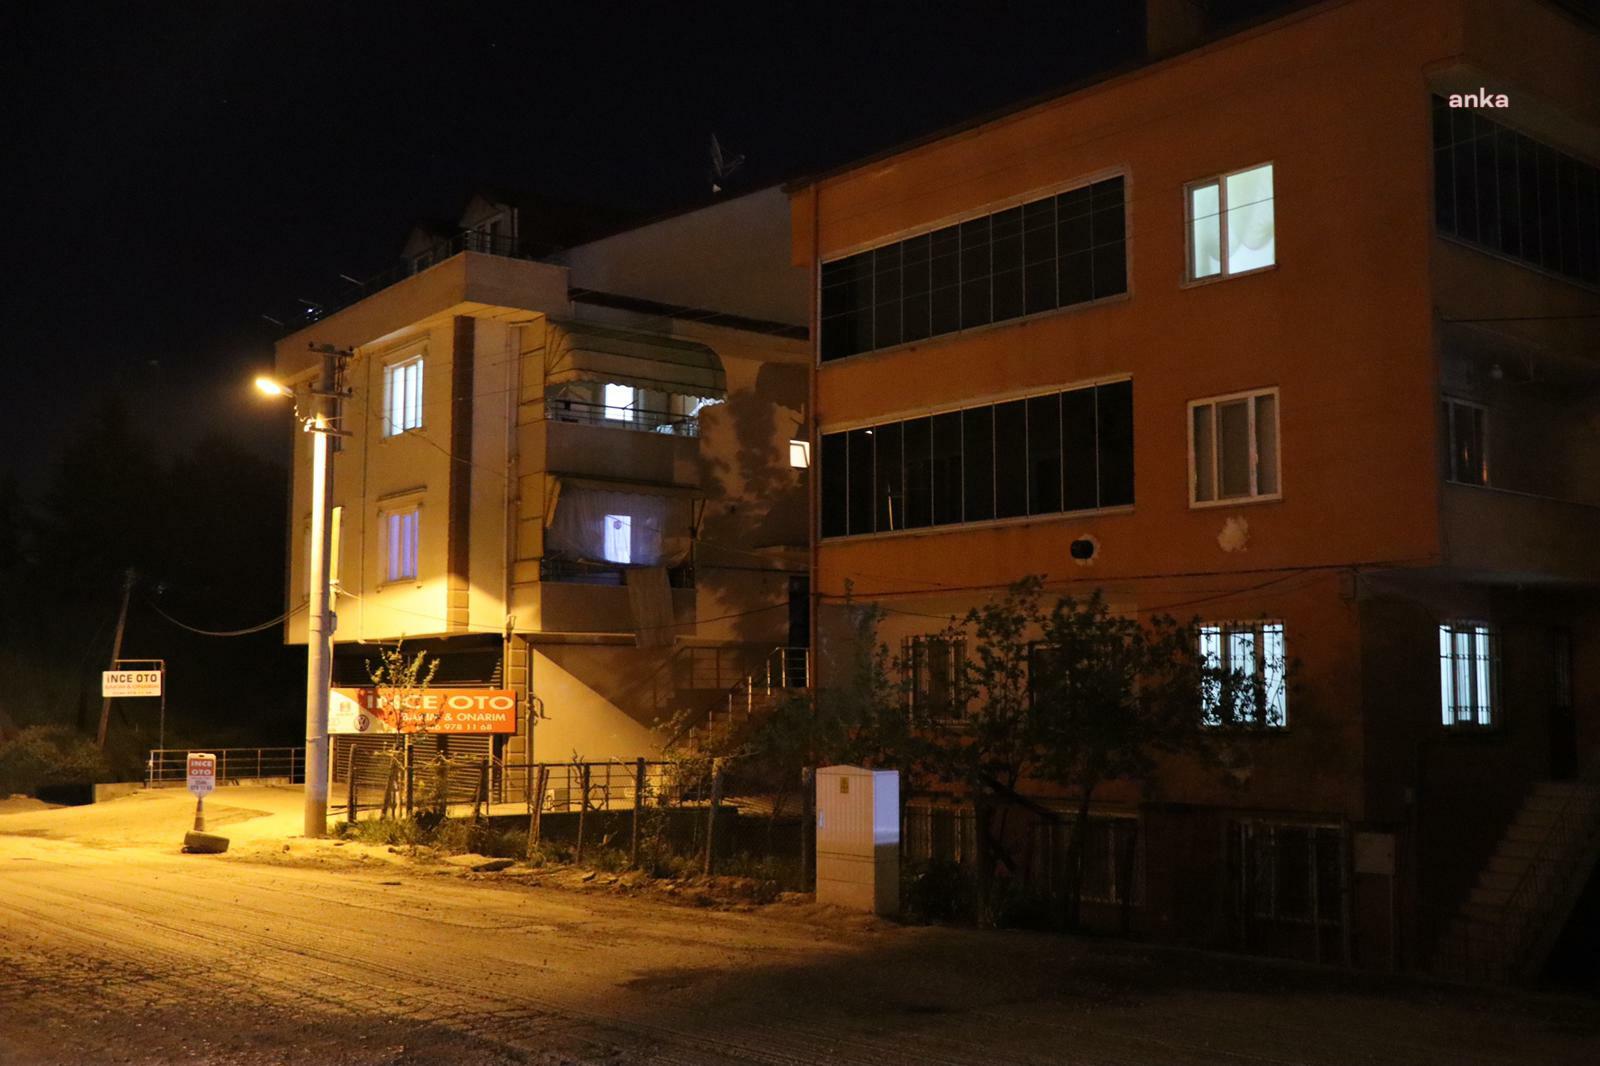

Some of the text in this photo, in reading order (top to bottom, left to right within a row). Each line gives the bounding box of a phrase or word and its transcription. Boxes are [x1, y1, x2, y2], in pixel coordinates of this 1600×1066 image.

[136, 674, 157, 683] OTO
[448, 695, 514, 710] OTO
[444, 712, 452, 721] &
[457, 712, 506, 721] ONARIM
